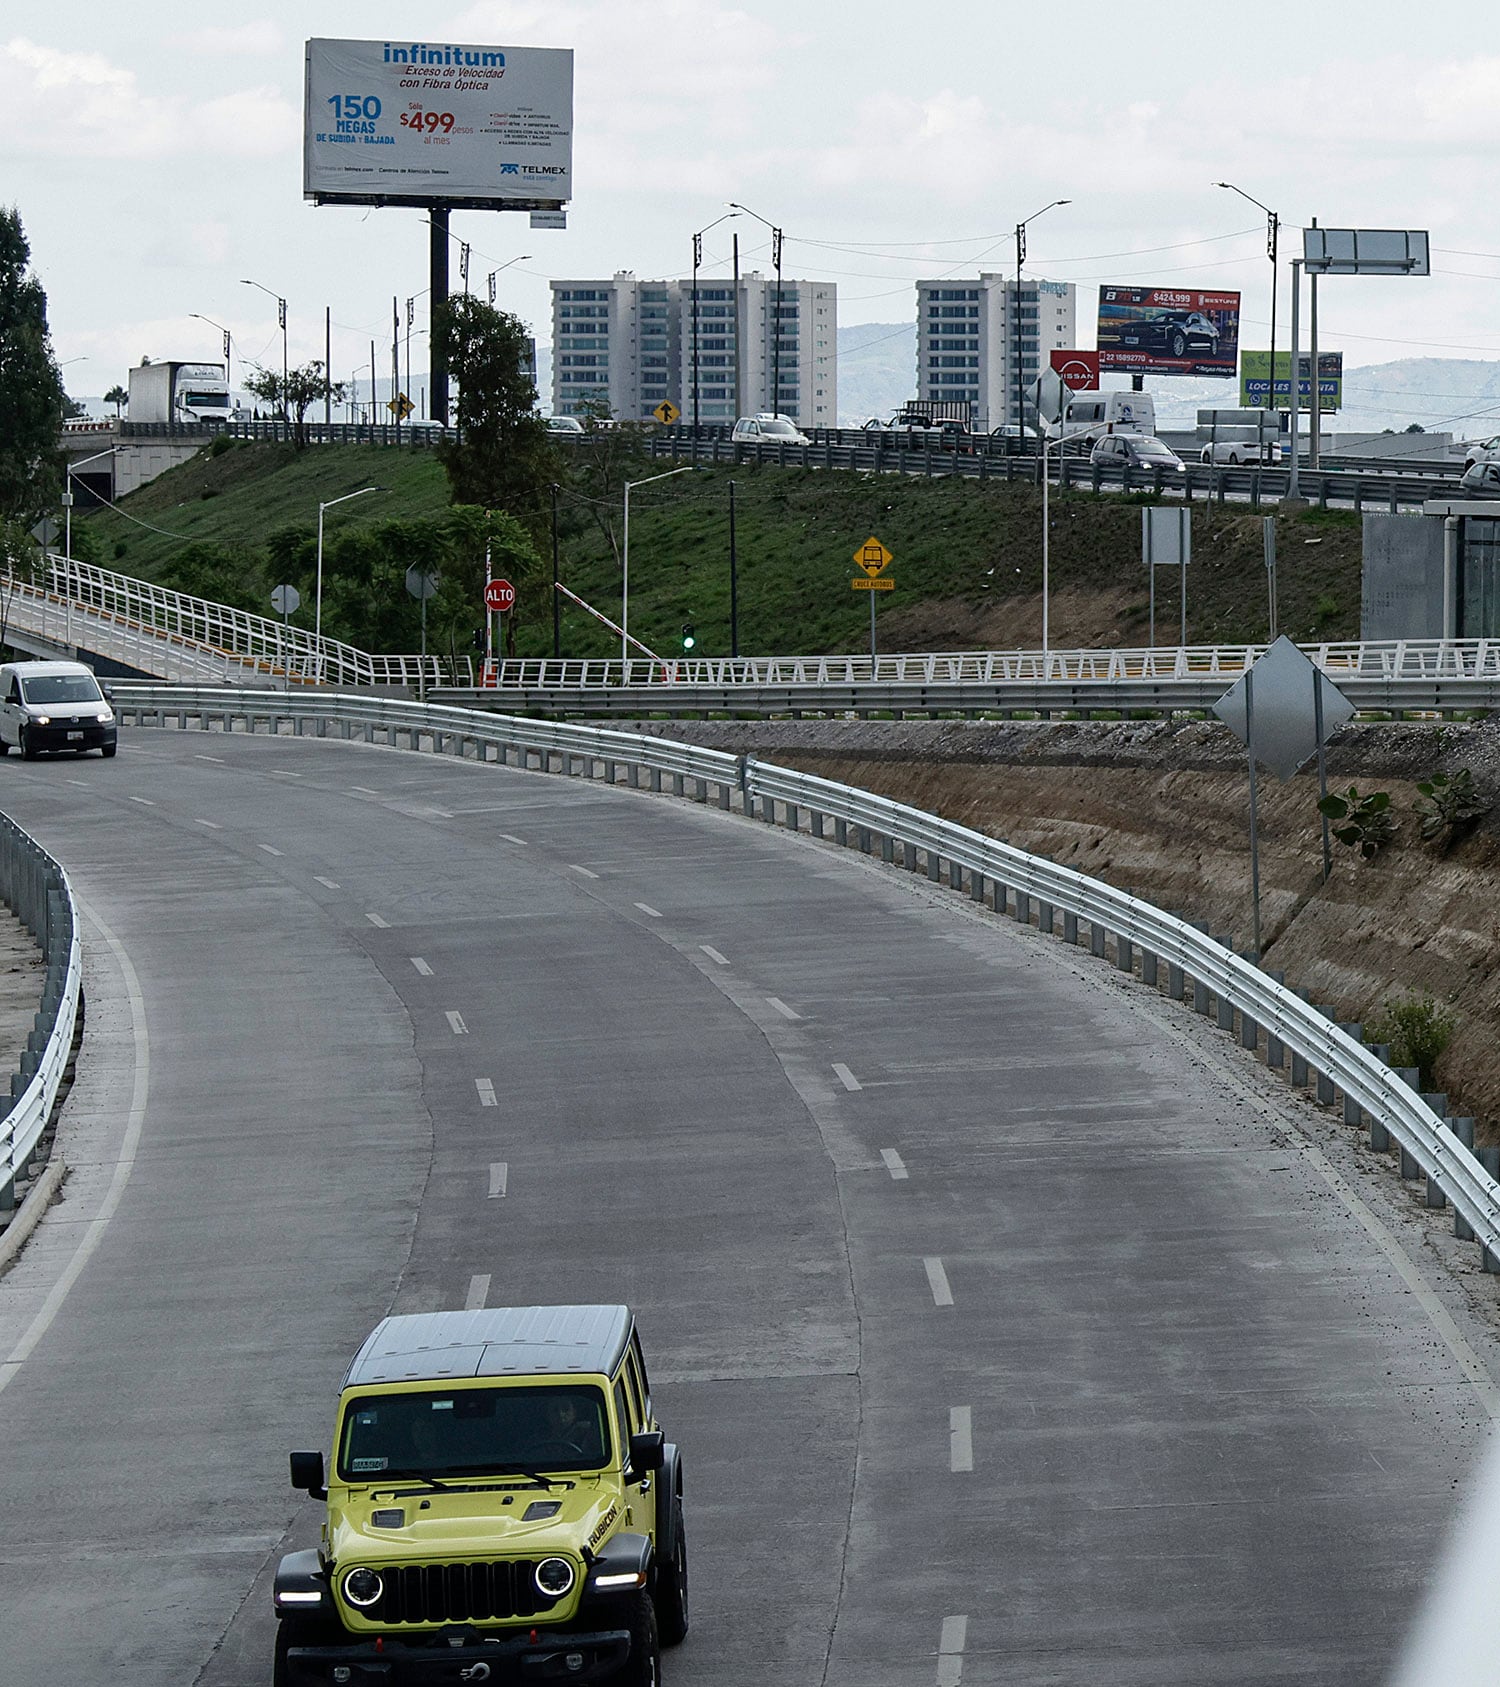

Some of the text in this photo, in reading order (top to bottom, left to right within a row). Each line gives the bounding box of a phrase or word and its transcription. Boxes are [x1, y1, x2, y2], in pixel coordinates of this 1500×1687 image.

[384, 43, 505, 67] infinitum
[405, 65, 505, 79] Exceso de Velocidad
[399, 78, 489, 91] con Fibra Óptica
[328, 94, 382, 120] 150
[336, 120, 376, 134] MEGAS
[400, 111, 455, 134] $499
[452, 126, 474, 136] pesos
[316, 133, 327, 142] DE
[328, 134, 356, 143] SUBIDA
[364, 135, 395, 145] BAJADA
[423, 136, 451, 145] al mes
[521, 165, 566, 175] TELMEX
[1153, 292, 1191, 303] $424,999
[1307, 383, 1335, 392] VNTA
[486, 589, 513, 601] ALTO
[588, 1504, 617, 1548] RUBICON
